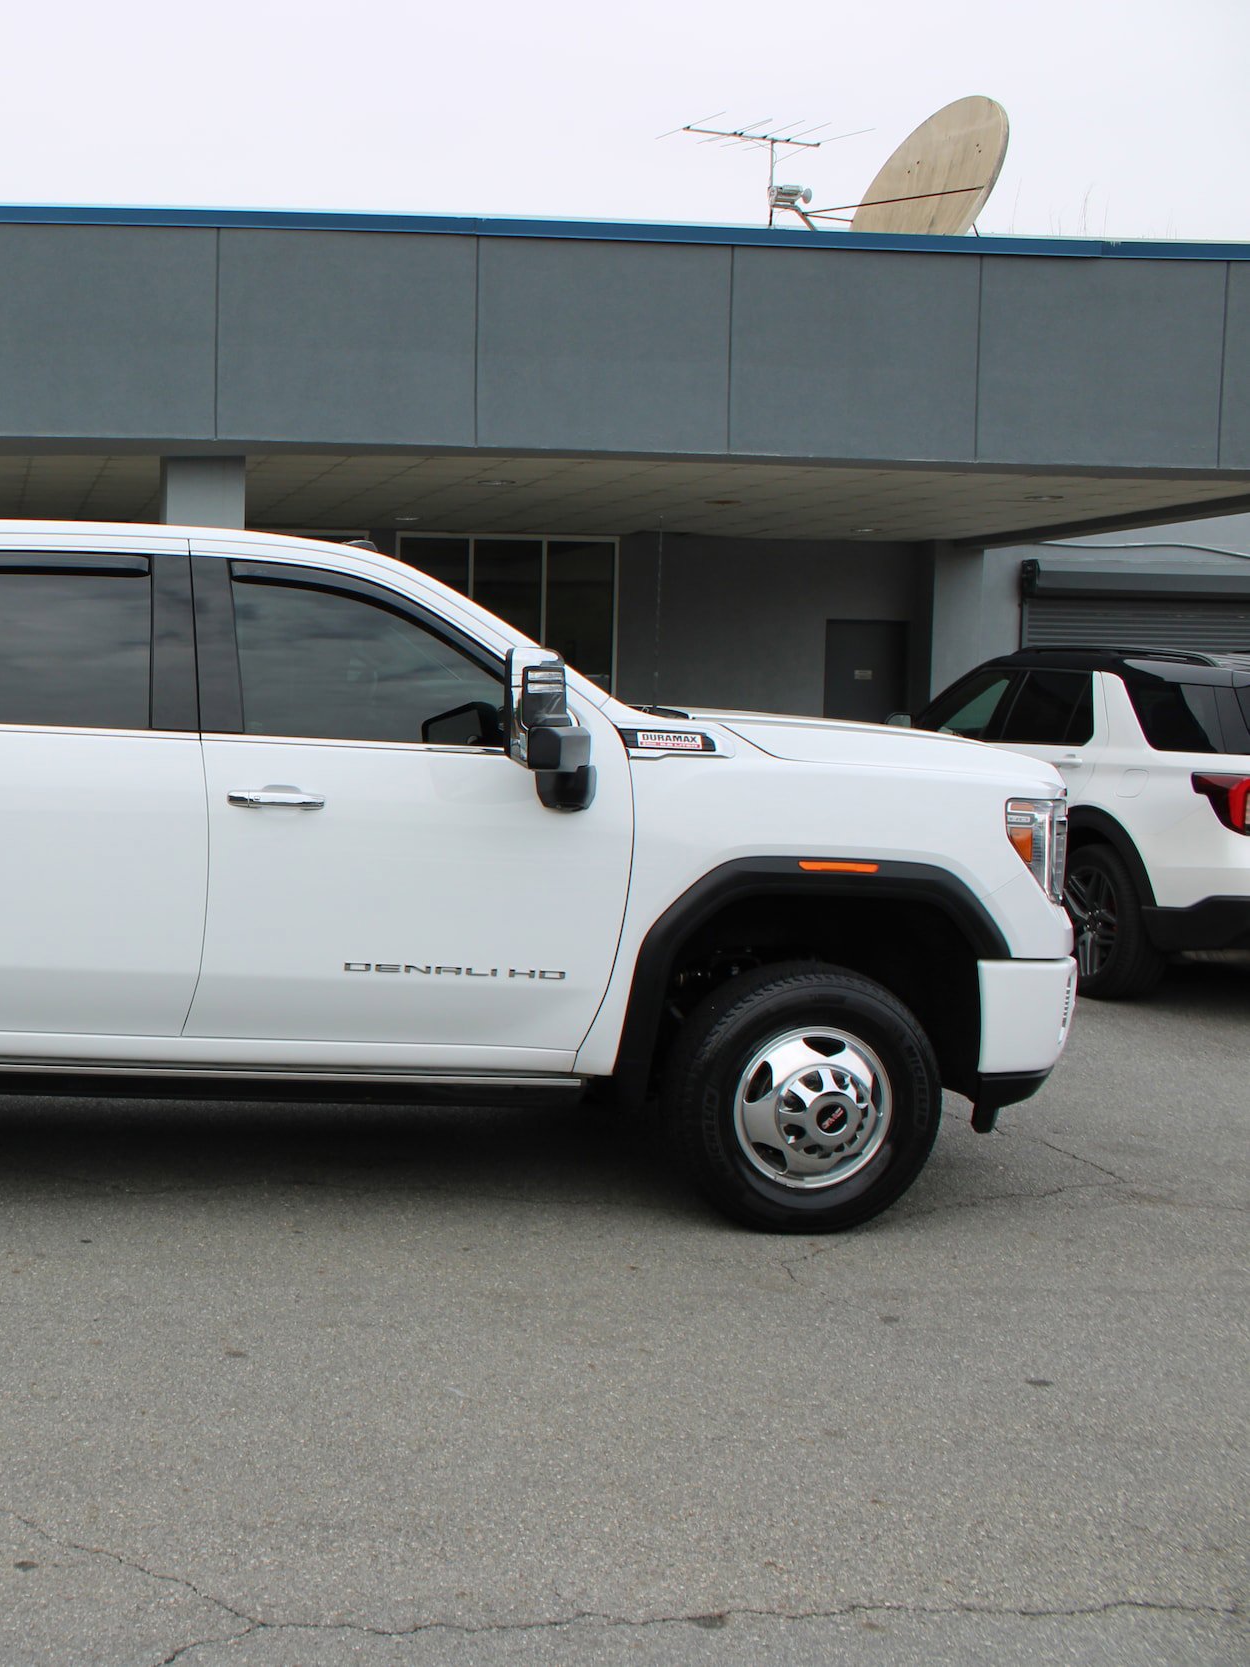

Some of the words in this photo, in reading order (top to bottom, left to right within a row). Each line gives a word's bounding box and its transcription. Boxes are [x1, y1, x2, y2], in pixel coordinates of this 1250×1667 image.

[642, 733, 698, 743] DURAMAX
[344, 962, 497, 977] DENALI
[508, 968, 566, 980] HD
[821, 1107, 844, 1129] GMC
